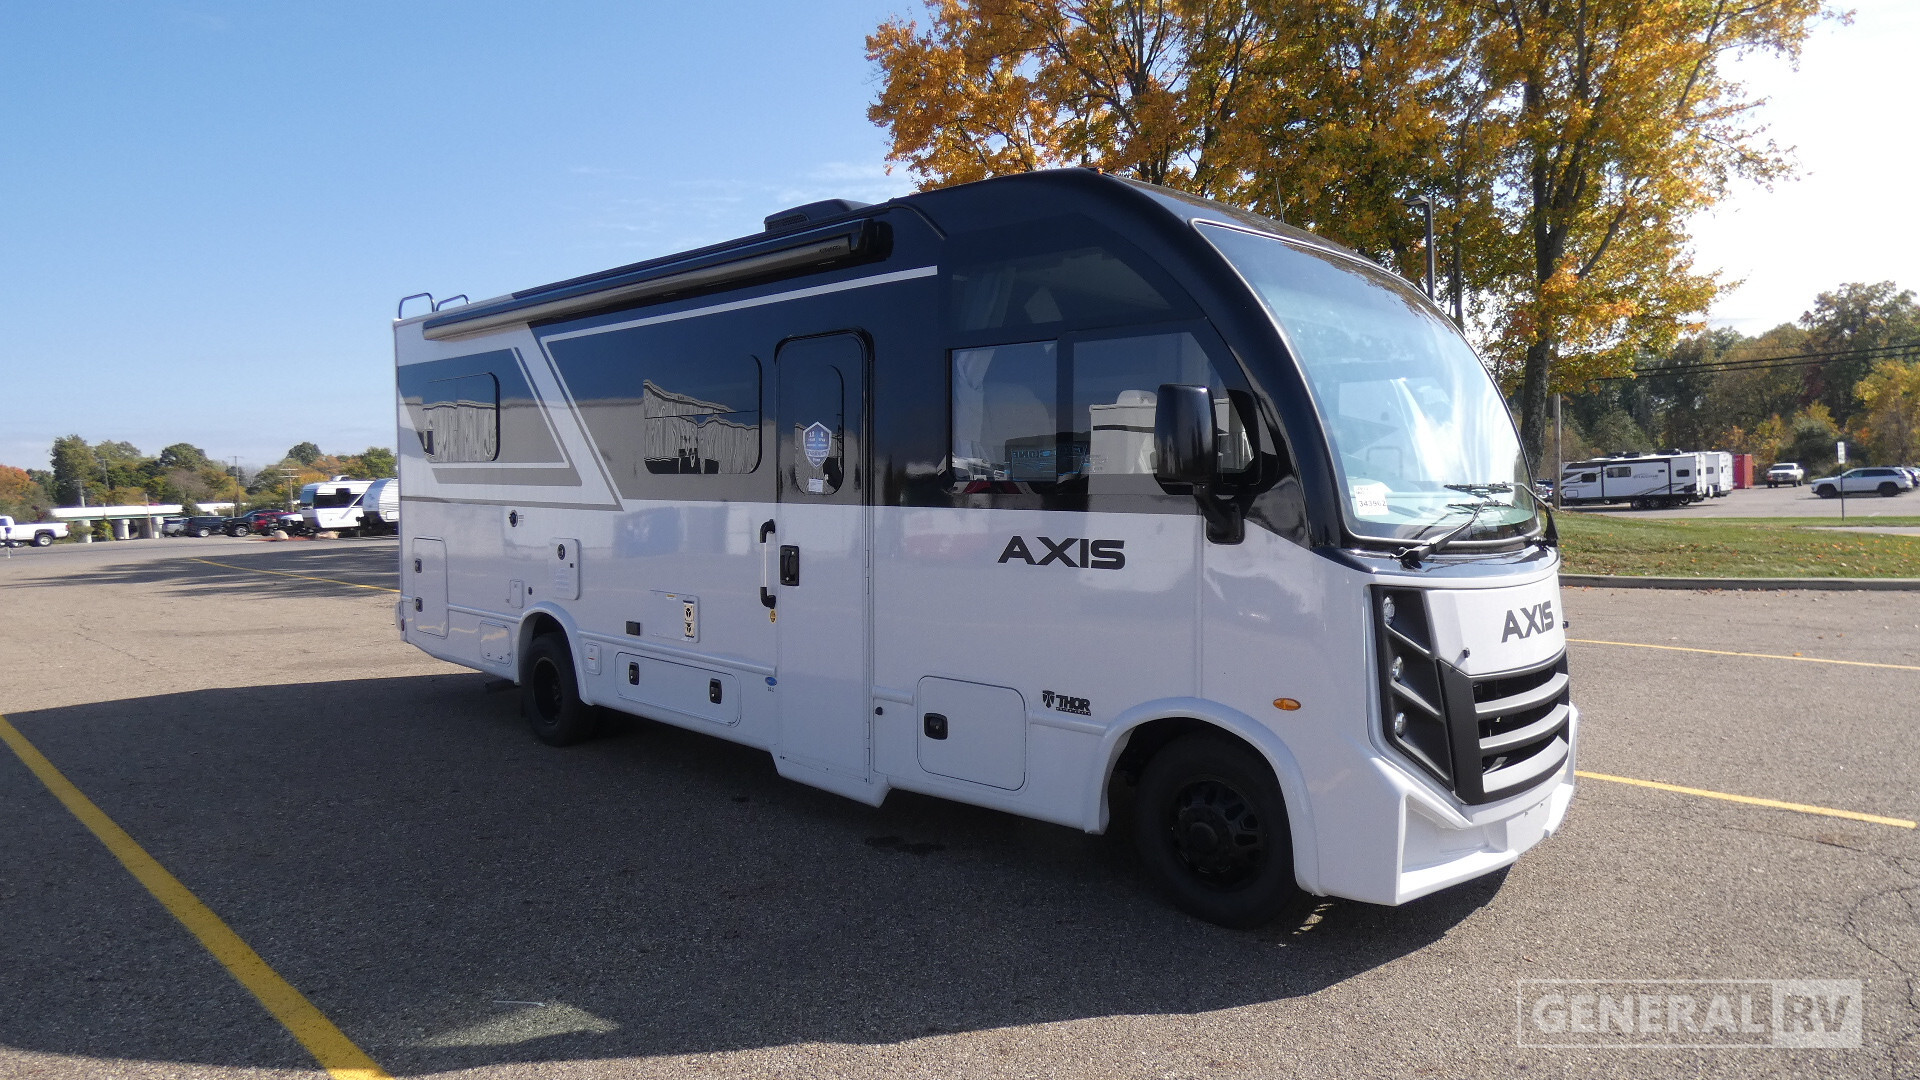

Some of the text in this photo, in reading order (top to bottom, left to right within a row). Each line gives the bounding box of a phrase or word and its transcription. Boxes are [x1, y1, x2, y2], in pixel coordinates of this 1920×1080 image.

[997, 535, 1125, 570] AXIS
[1501, 600, 1554, 643] AXIS
[1056, 694, 1091, 712] THOR
